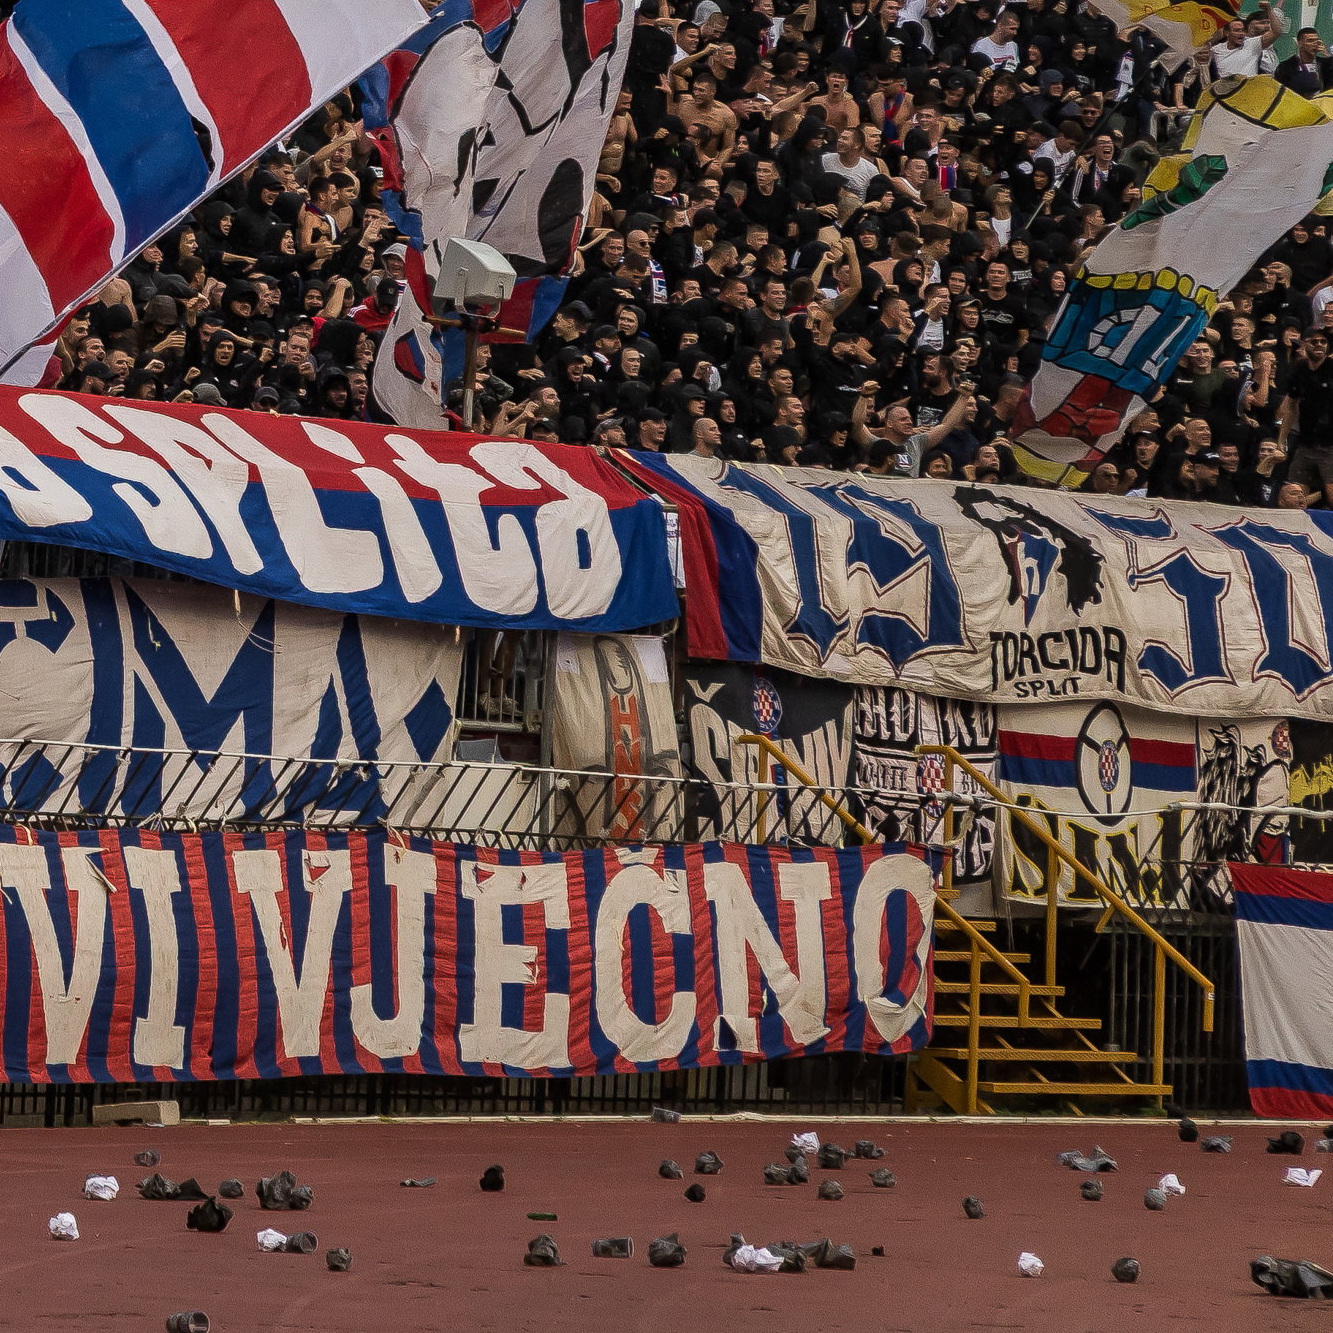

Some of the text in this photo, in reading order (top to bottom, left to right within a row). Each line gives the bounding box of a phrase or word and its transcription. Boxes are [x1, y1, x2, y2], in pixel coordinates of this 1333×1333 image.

[989, 626, 1127, 694] TORCIDA
[1014, 676, 1082, 698] SPLIT
[231, 845, 935, 1069] VJEČNO
